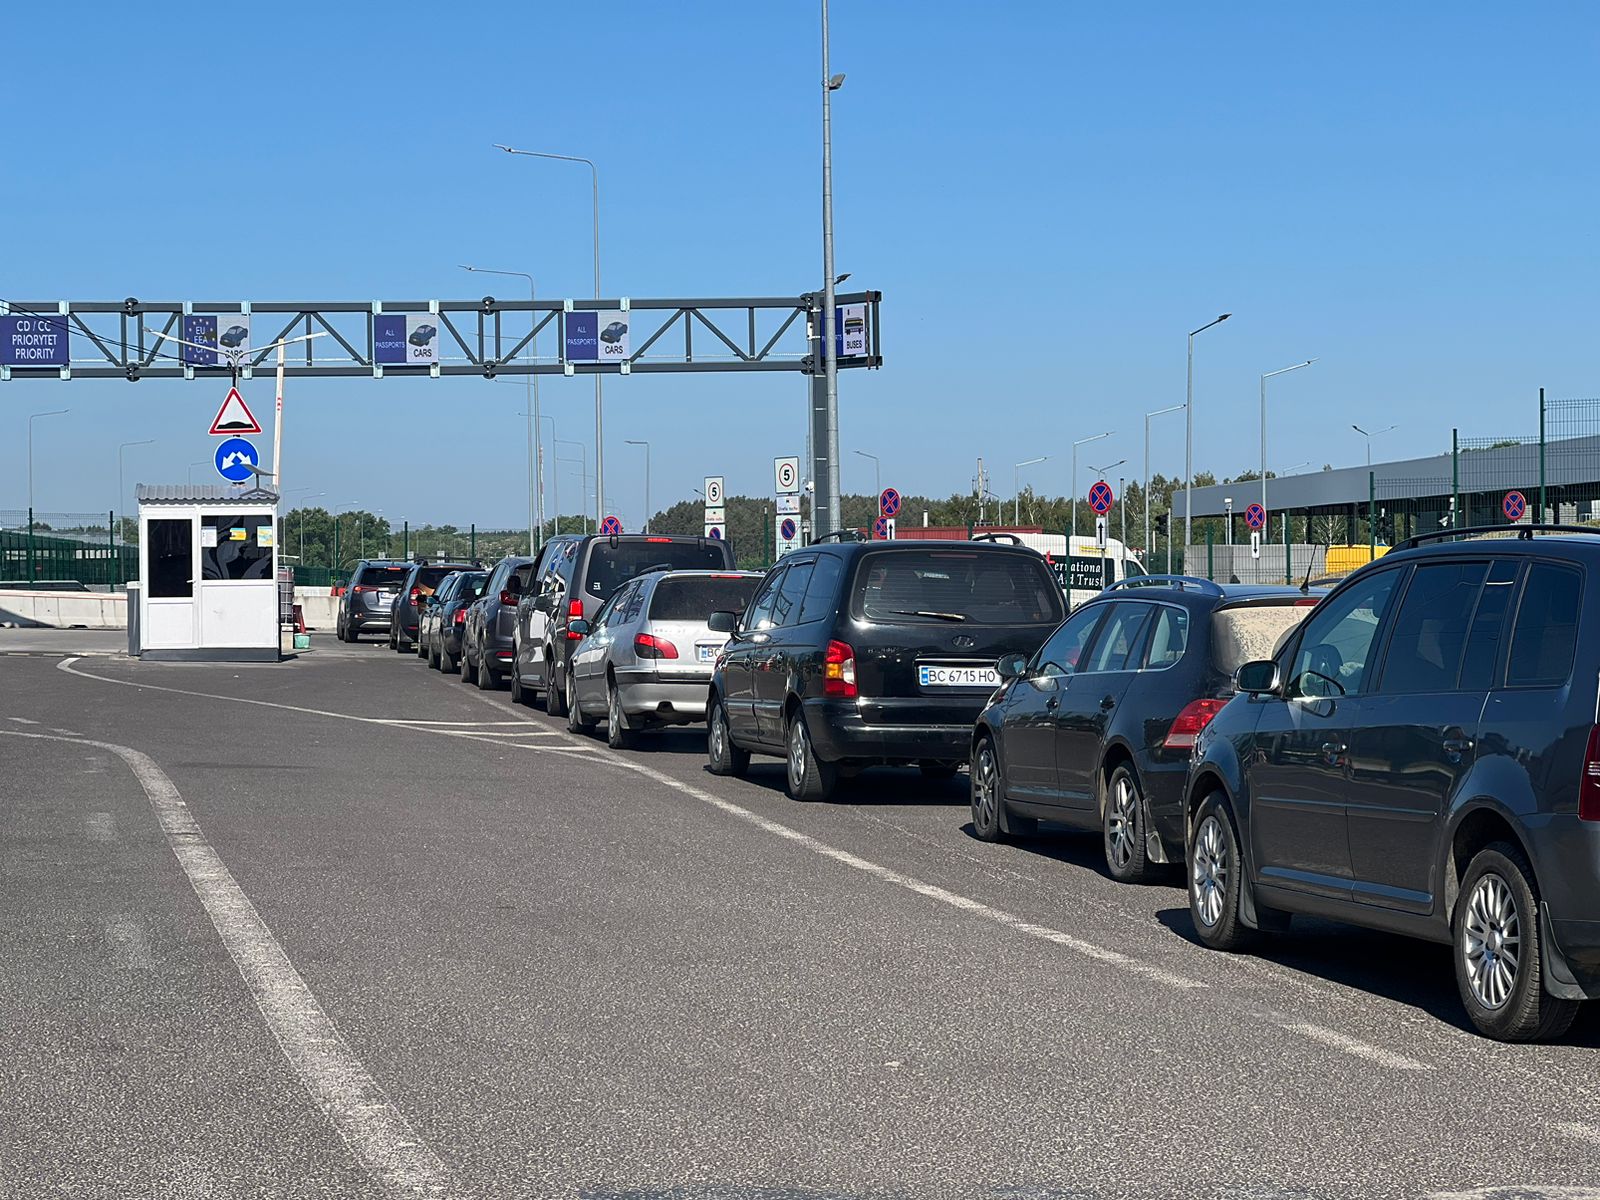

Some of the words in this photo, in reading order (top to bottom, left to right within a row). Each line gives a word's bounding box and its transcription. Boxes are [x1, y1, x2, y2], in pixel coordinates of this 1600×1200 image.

[195, 326, 206, 335] EU
[384, 329, 395, 337] ALL
[577, 326, 587, 334] ALL
[12, 334, 58, 346] PRIORYTET
[193, 335, 208, 344] EEA
[567, 338, 597, 346] PASSPORTS
[846, 339, 863, 350] BUSES
[375, 341, 406, 349] PASSPORTS
[604, 345, 624, 355] CARS
[15, 348, 55, 359] PRIORITY
[413, 348, 433, 358] CARS
[783, 469, 790, 481] 5
[711, 487, 717, 497] 5
[928, 670, 946, 683] BC
[948, 670, 976, 683] 6715
